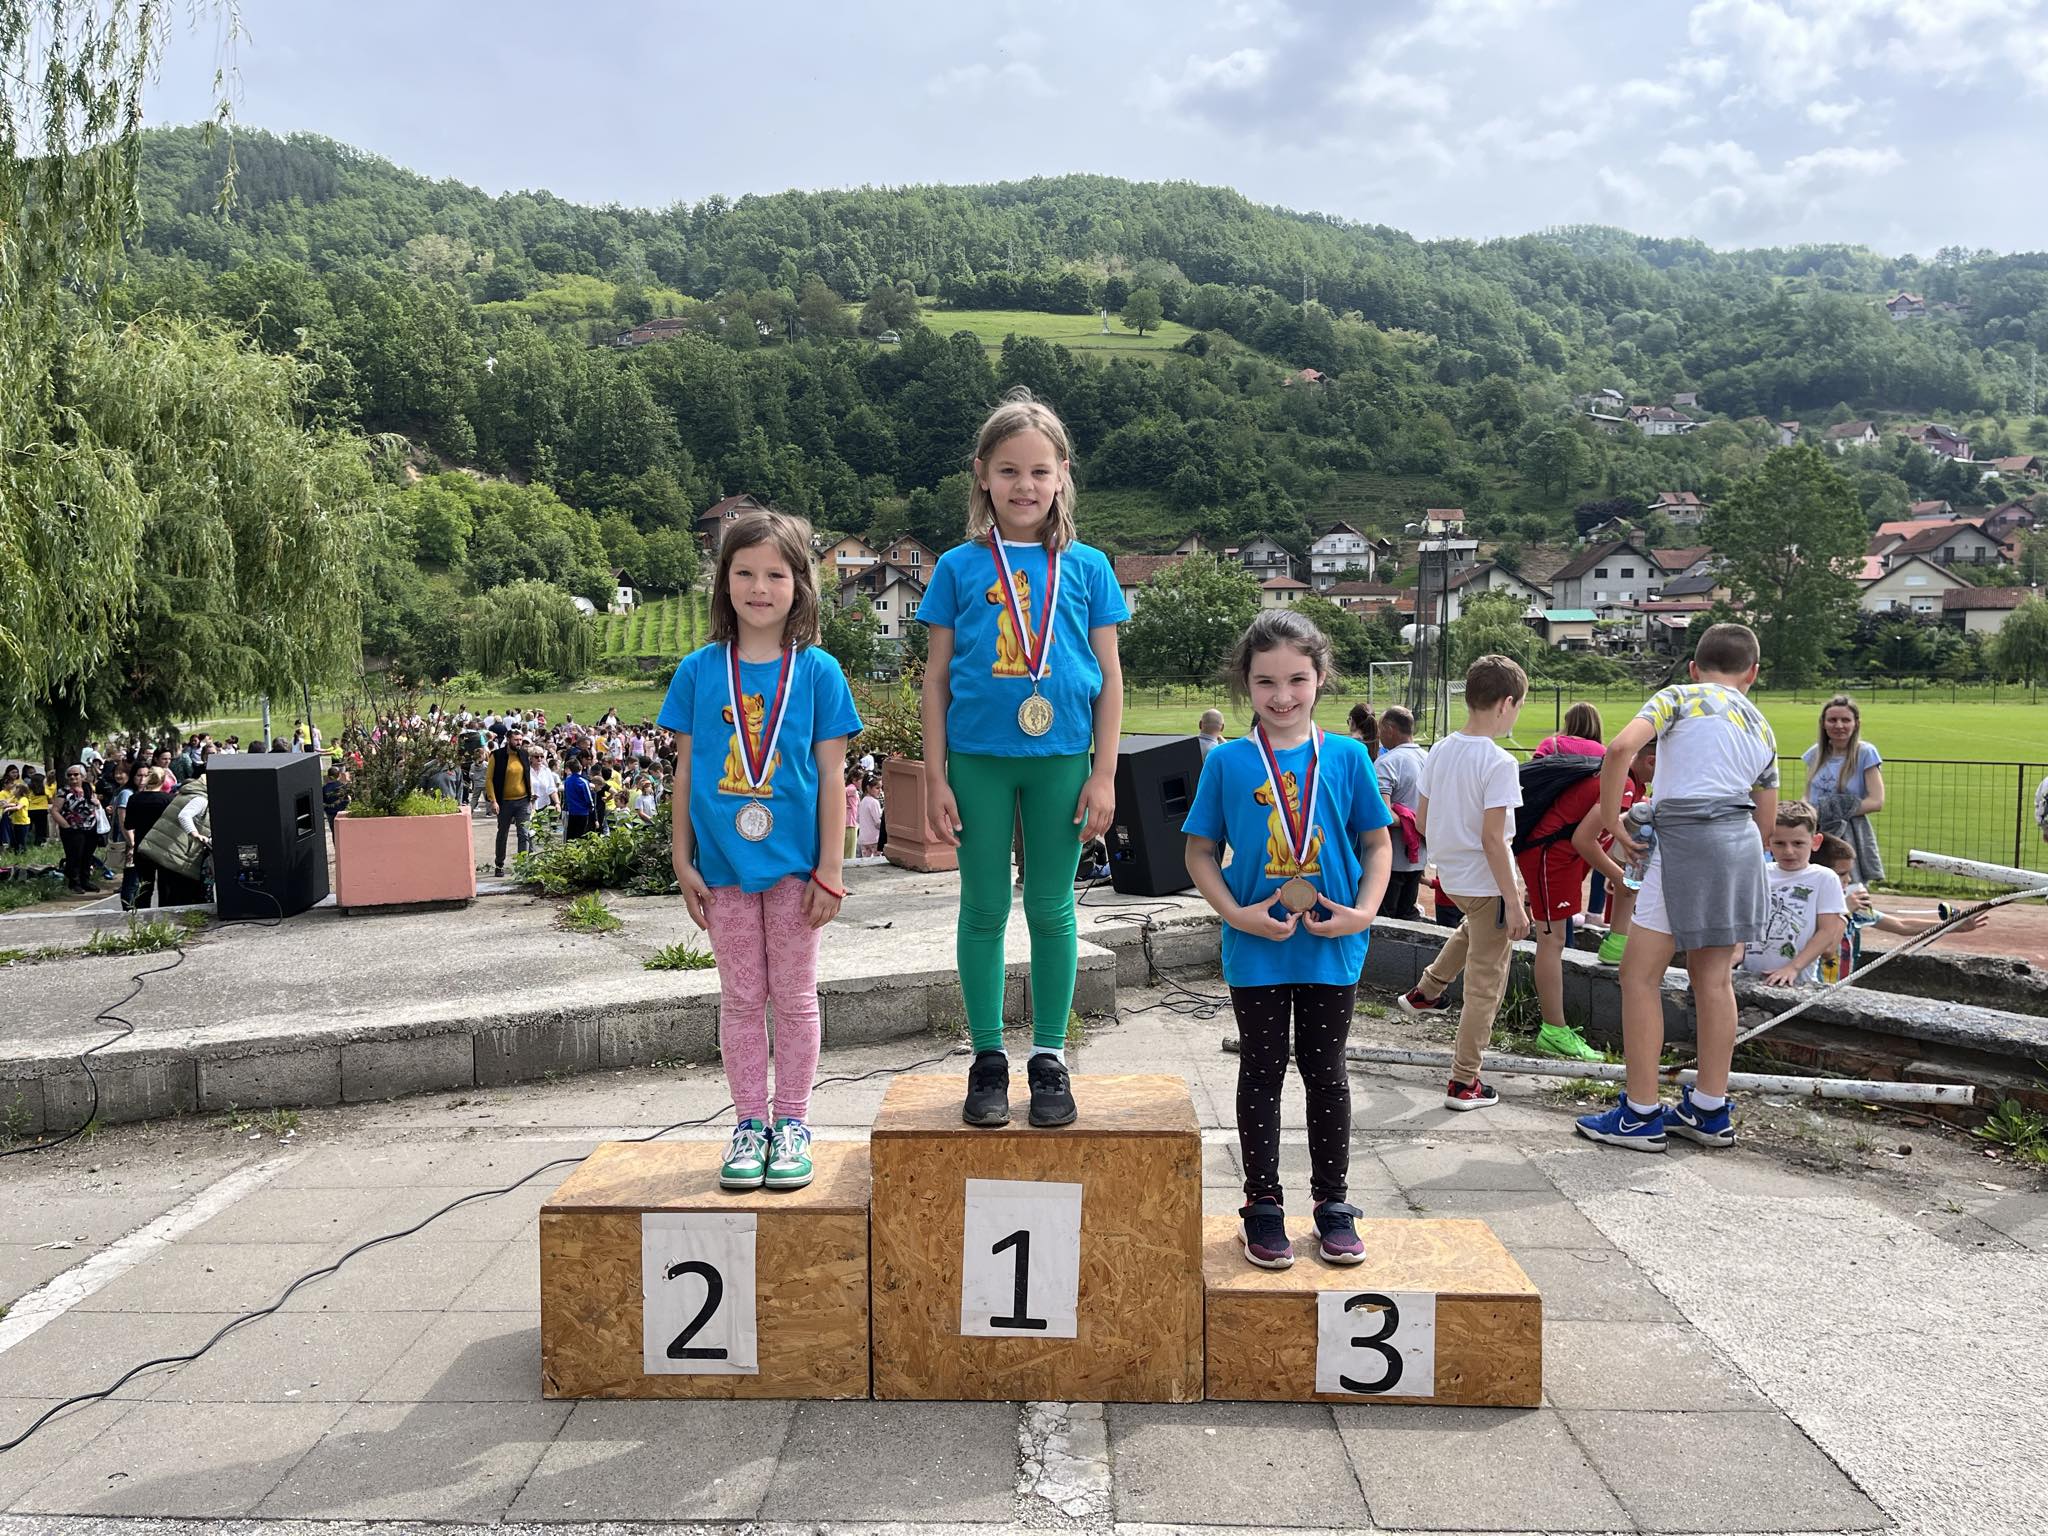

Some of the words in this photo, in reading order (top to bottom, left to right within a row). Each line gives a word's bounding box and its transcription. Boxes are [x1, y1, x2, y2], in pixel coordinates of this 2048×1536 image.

[667, 1260, 729, 1360] 2
[989, 1230, 1048, 1330] 1
[1339, 1294, 1405, 1395] 3
